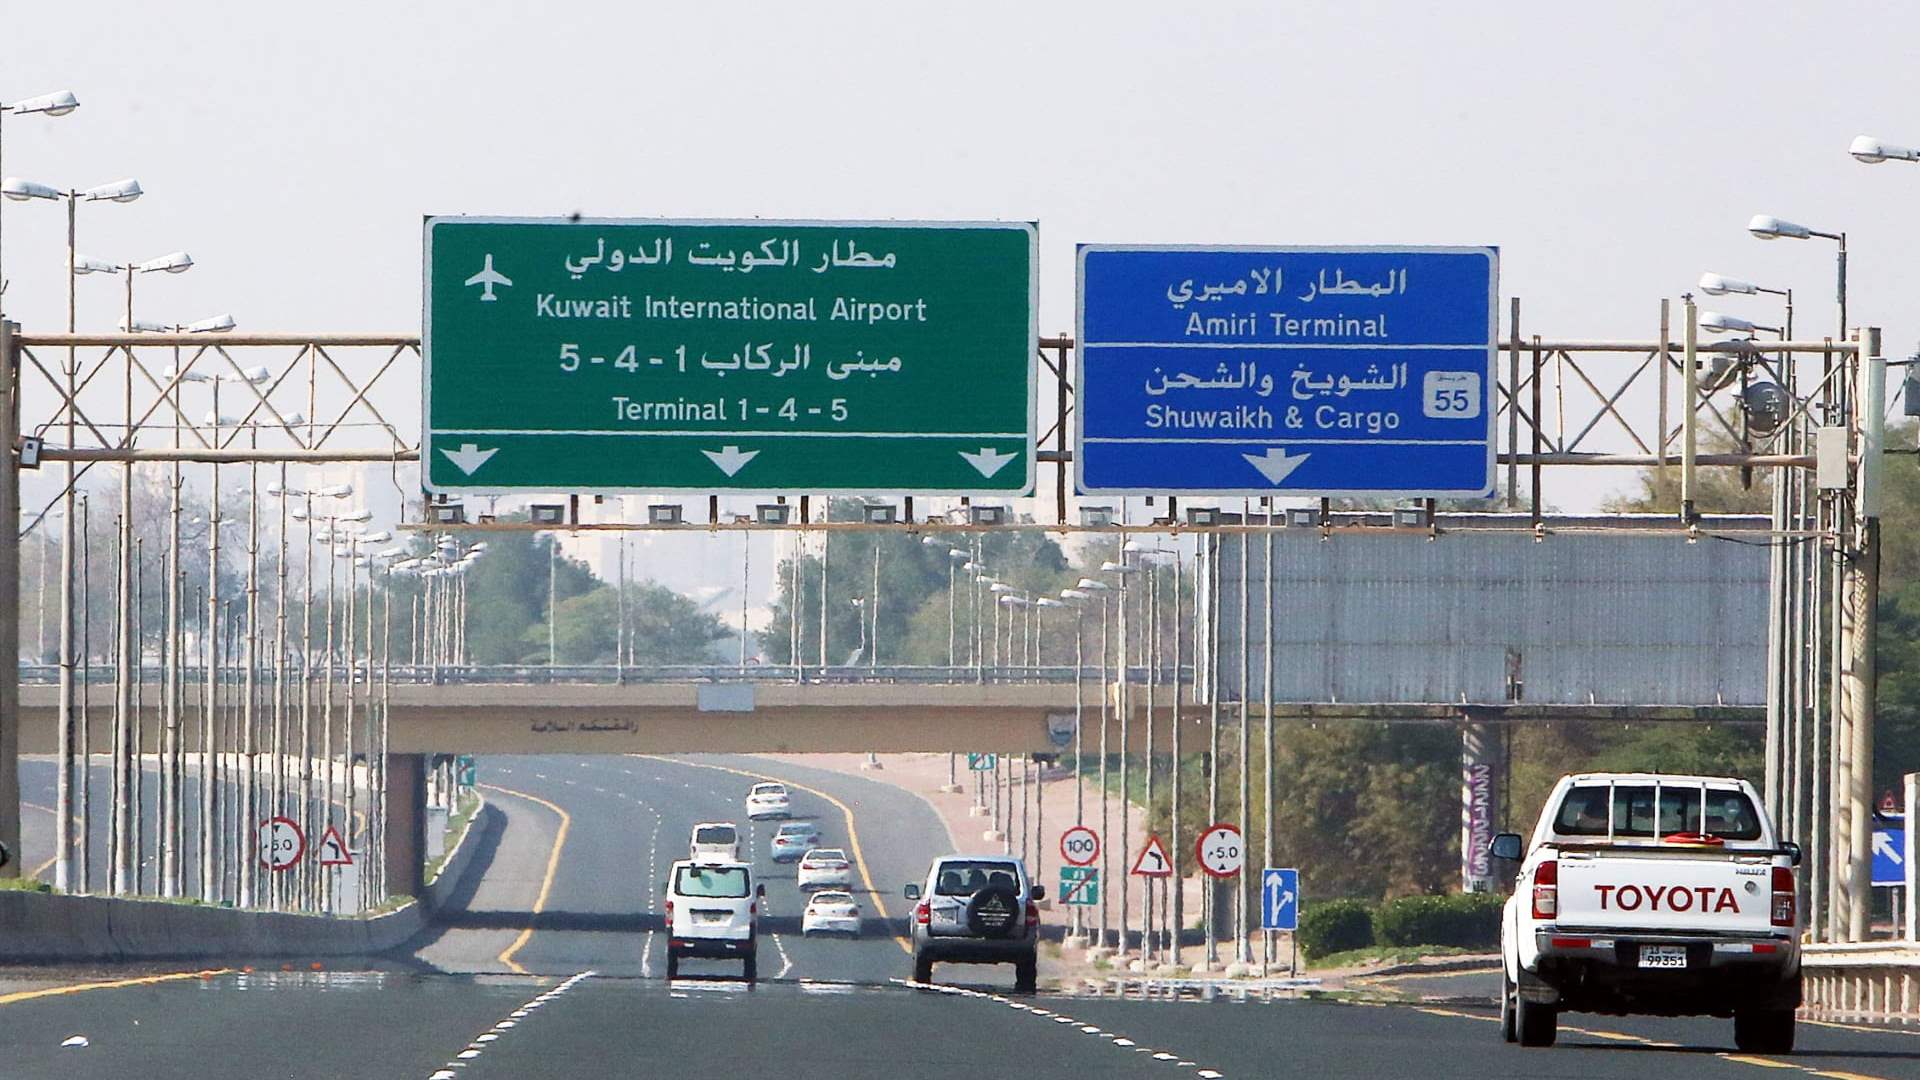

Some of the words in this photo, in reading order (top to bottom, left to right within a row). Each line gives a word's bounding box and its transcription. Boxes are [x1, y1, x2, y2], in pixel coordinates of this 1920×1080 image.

[565, 238, 672, 279] الدولي
[688, 239, 798, 273] الكويت
[812, 239, 897, 274] مطار
[1167, 267, 1282, 308] الاميري
[1298, 268, 1406, 302] المطار
[537, 294, 631, 318] Kuwait
[645, 296, 817, 321] International
[830, 298, 927, 324] Airport
[1185, 312, 1256, 336] Amiri
[1270, 313, 1387, 338] Terminal
[559, 344, 579, 372] 5
[614, 346, 638, 372] 4
[701, 343, 810, 377] الركاب
[826, 347, 902, 380] مبنى
[1145, 362, 1274, 397] والشحن
[1290, 362, 1407, 399] الشويخ
[612, 397, 726, 421] Terminal
[1435, 390, 1469, 412] 55
[1145, 405, 1273, 429] Shuwaikh
[1284, 406, 1303, 429] &
[1315, 406, 1400, 434] Cargo
[1066, 839, 1094, 853] 100
[1216, 846, 1238, 859] 5.0
[1594, 885, 1740, 913] TOYOTA
